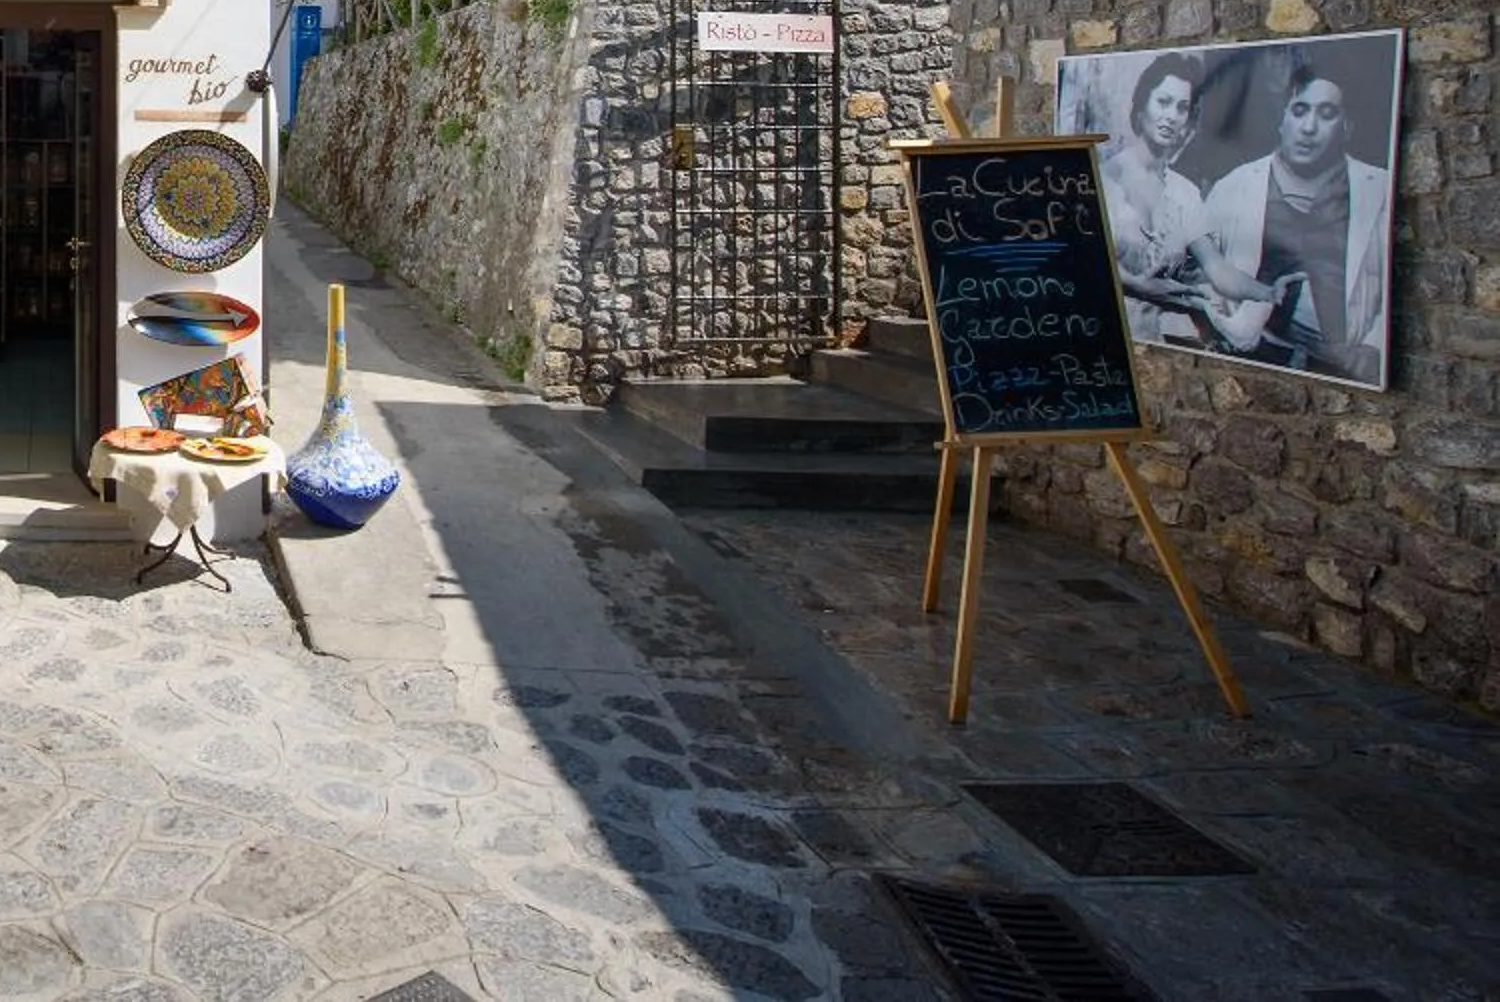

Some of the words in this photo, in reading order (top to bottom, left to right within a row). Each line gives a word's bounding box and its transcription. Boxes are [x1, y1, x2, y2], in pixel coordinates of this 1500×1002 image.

[777, 23, 825, 43] Pizza
[124, 53, 221, 83] gourmet
[187, 75, 239, 106] bio
[931, 209, 987, 243] di
